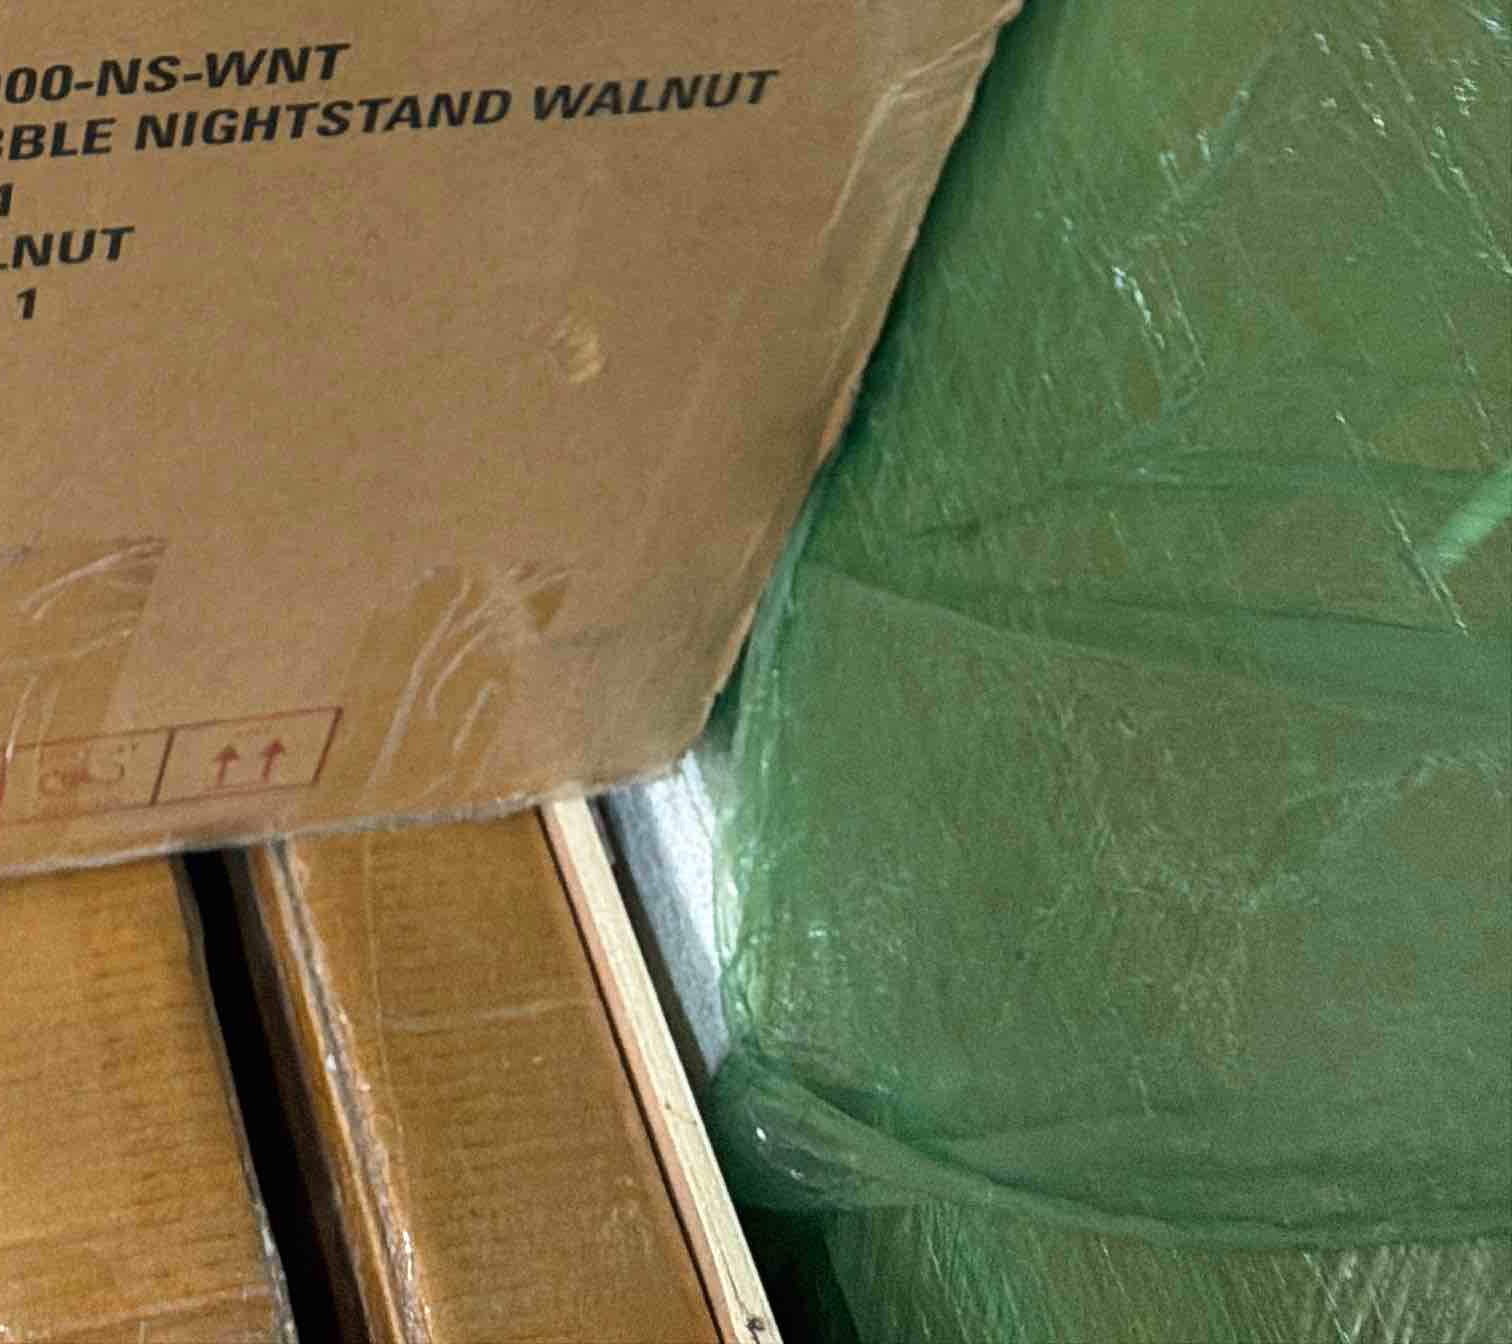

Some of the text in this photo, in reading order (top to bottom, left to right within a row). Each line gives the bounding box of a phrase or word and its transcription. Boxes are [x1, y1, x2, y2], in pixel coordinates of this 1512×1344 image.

[134, 88, 511, 152] NIGHTSTAND
[533, 69, 780, 121] WALNUT
[15, 287, 38, 321] 1
